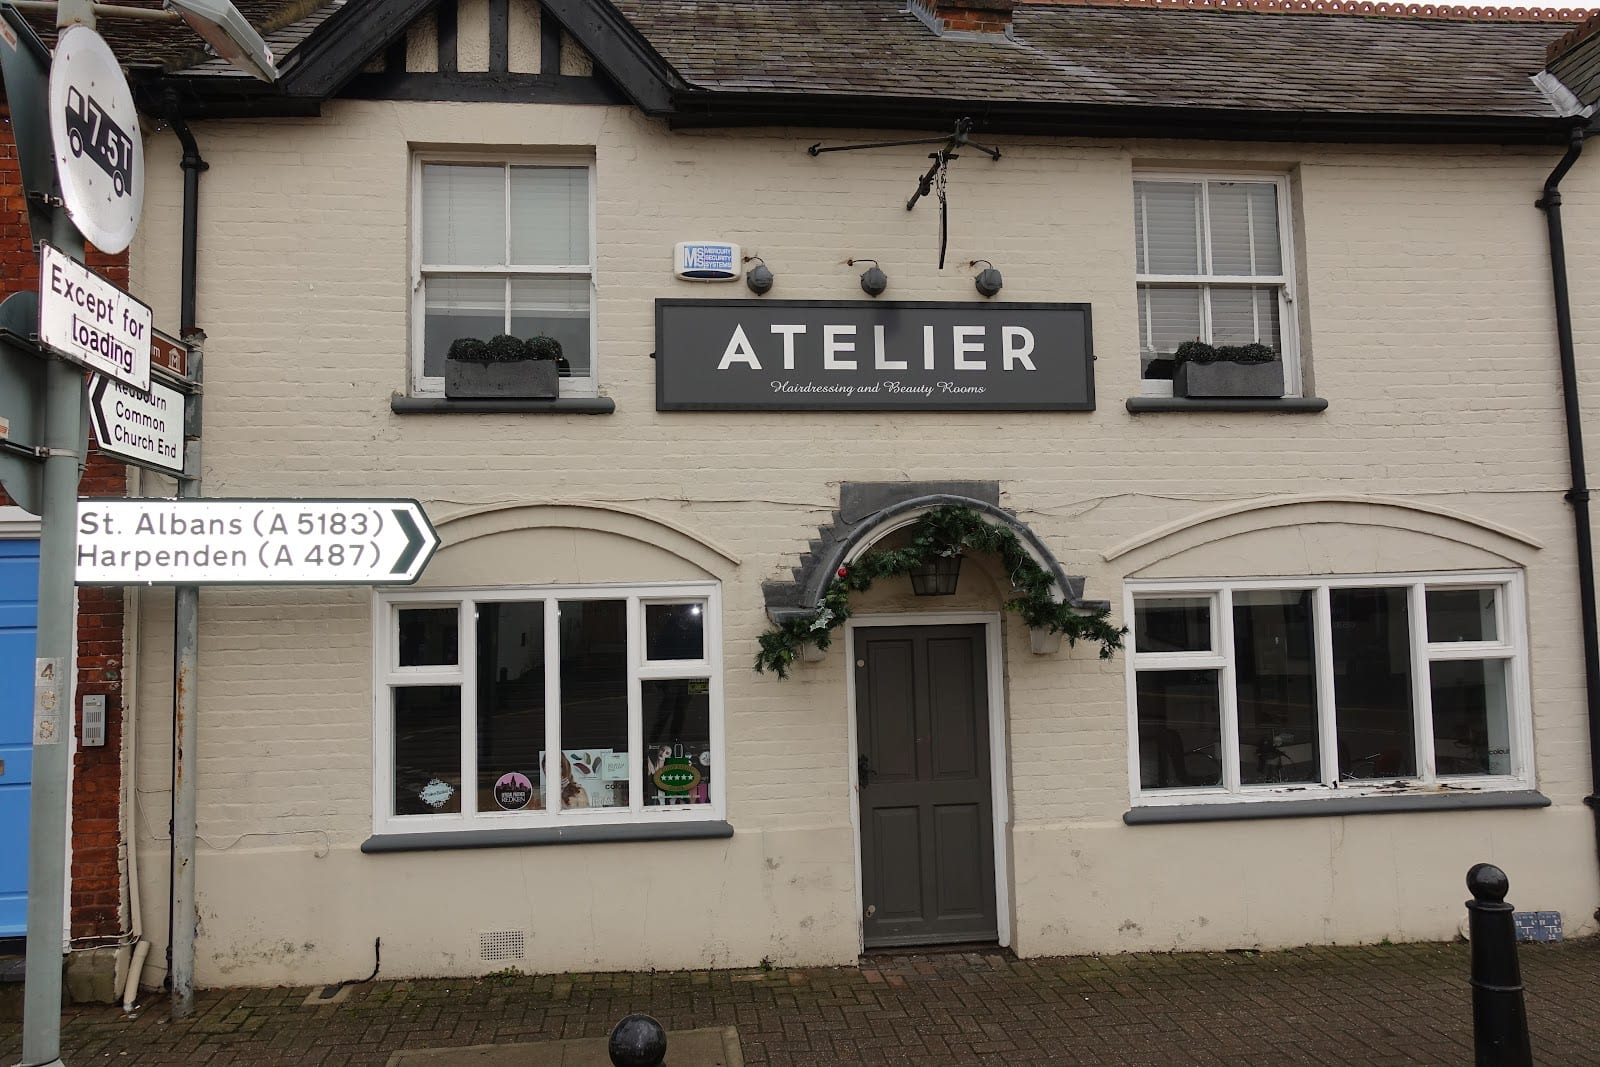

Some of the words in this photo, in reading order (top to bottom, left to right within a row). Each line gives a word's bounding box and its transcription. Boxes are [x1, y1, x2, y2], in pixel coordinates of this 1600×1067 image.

[89, 101, 131, 171] 7.5T
[51, 263, 114, 325] Except
[123, 308, 144, 340] for
[72, 313, 133, 374] loading
[717, 323, 1037, 371] ATELIER
[770, 380, 855, 397] Hairdressing
[857, 381, 881, 393] and
[883, 380, 934, 397] Beauty
[936, 381, 987, 393] Rooms
[115, 400, 165, 432] Common
[114, 424, 154, 452] Church
[158, 438, 176, 458] End
[79, 511, 122, 535] St.
[135, 512, 242, 535] Albans
[253, 509, 288, 537] (A
[297, 509, 384, 537] 5183)
[77, 544, 246, 571] Harpenden
[258, 540, 293, 568] (A
[304, 540, 380, 568] 487)
